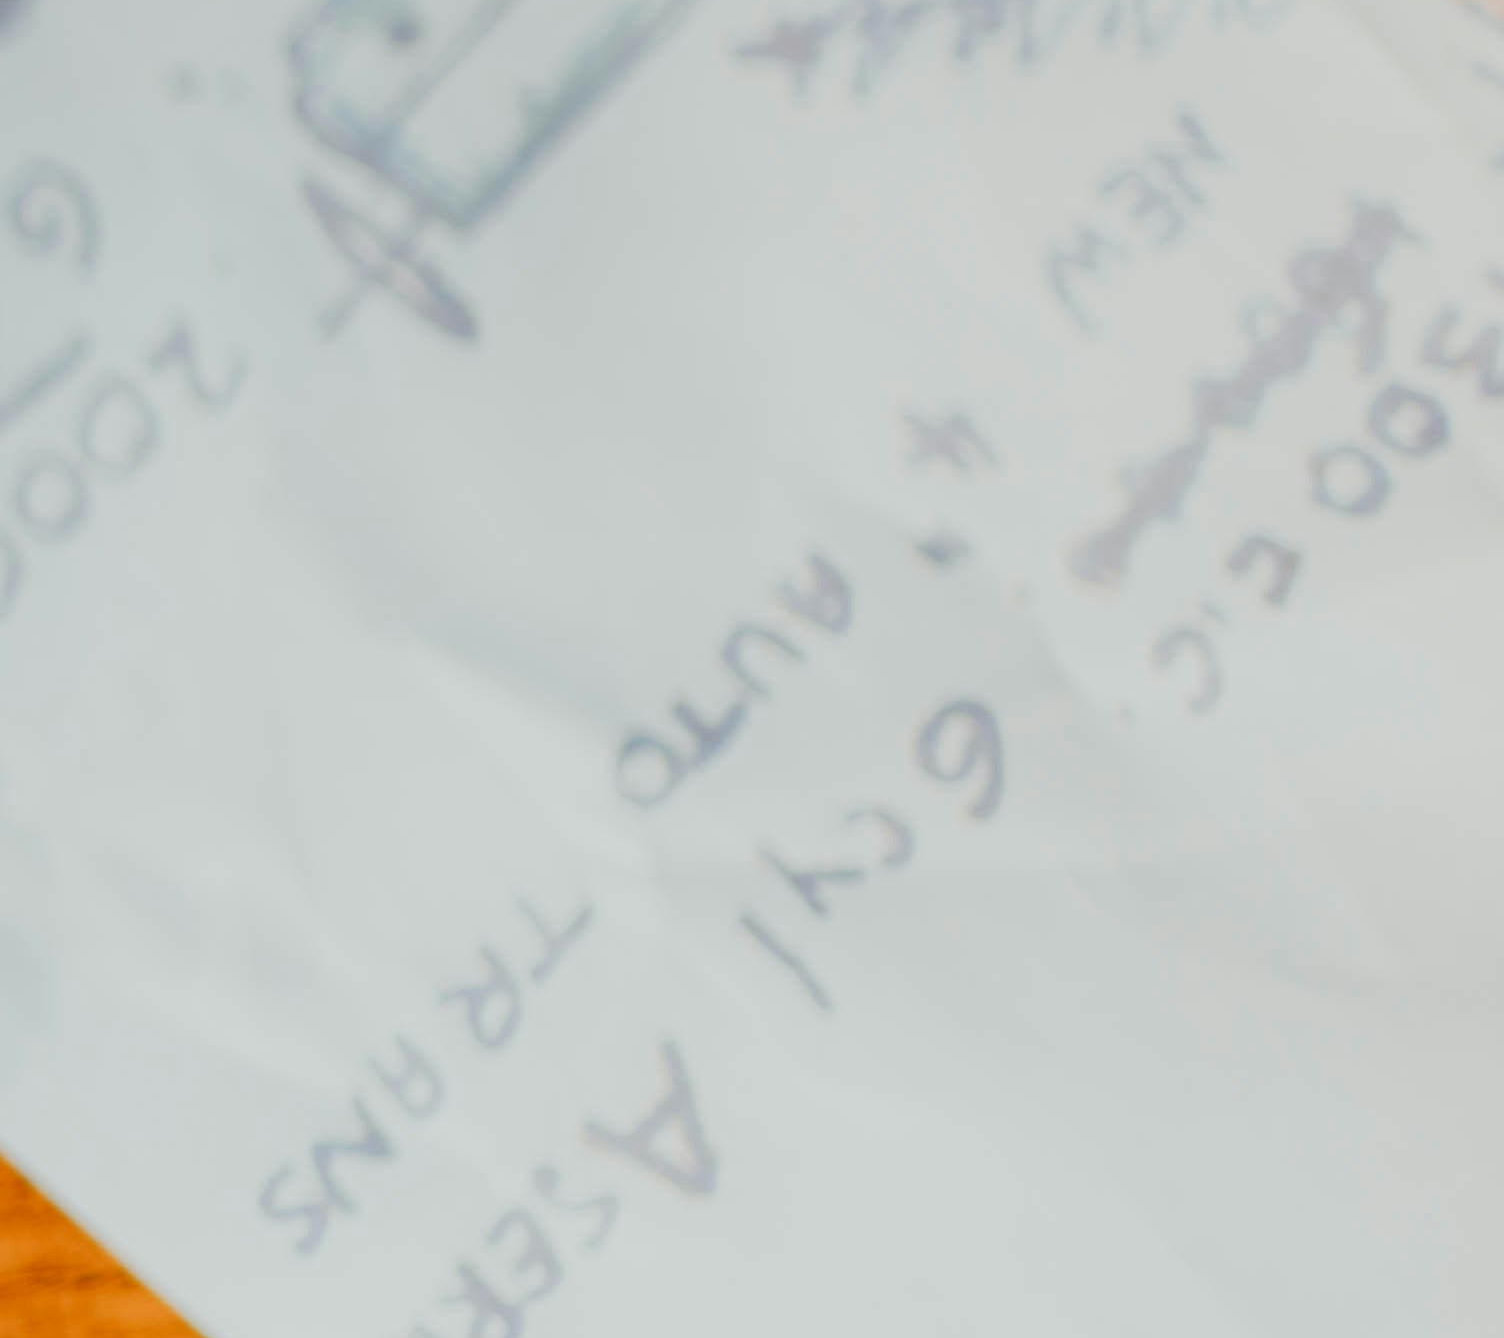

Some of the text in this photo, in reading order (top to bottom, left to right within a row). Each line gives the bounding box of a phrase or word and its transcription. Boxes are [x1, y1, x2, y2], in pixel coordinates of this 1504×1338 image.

[612, 549, 858, 811] AUTO
[913, 693, 1010, 823] 6
[256, 893, 596, 1257] TRANS
